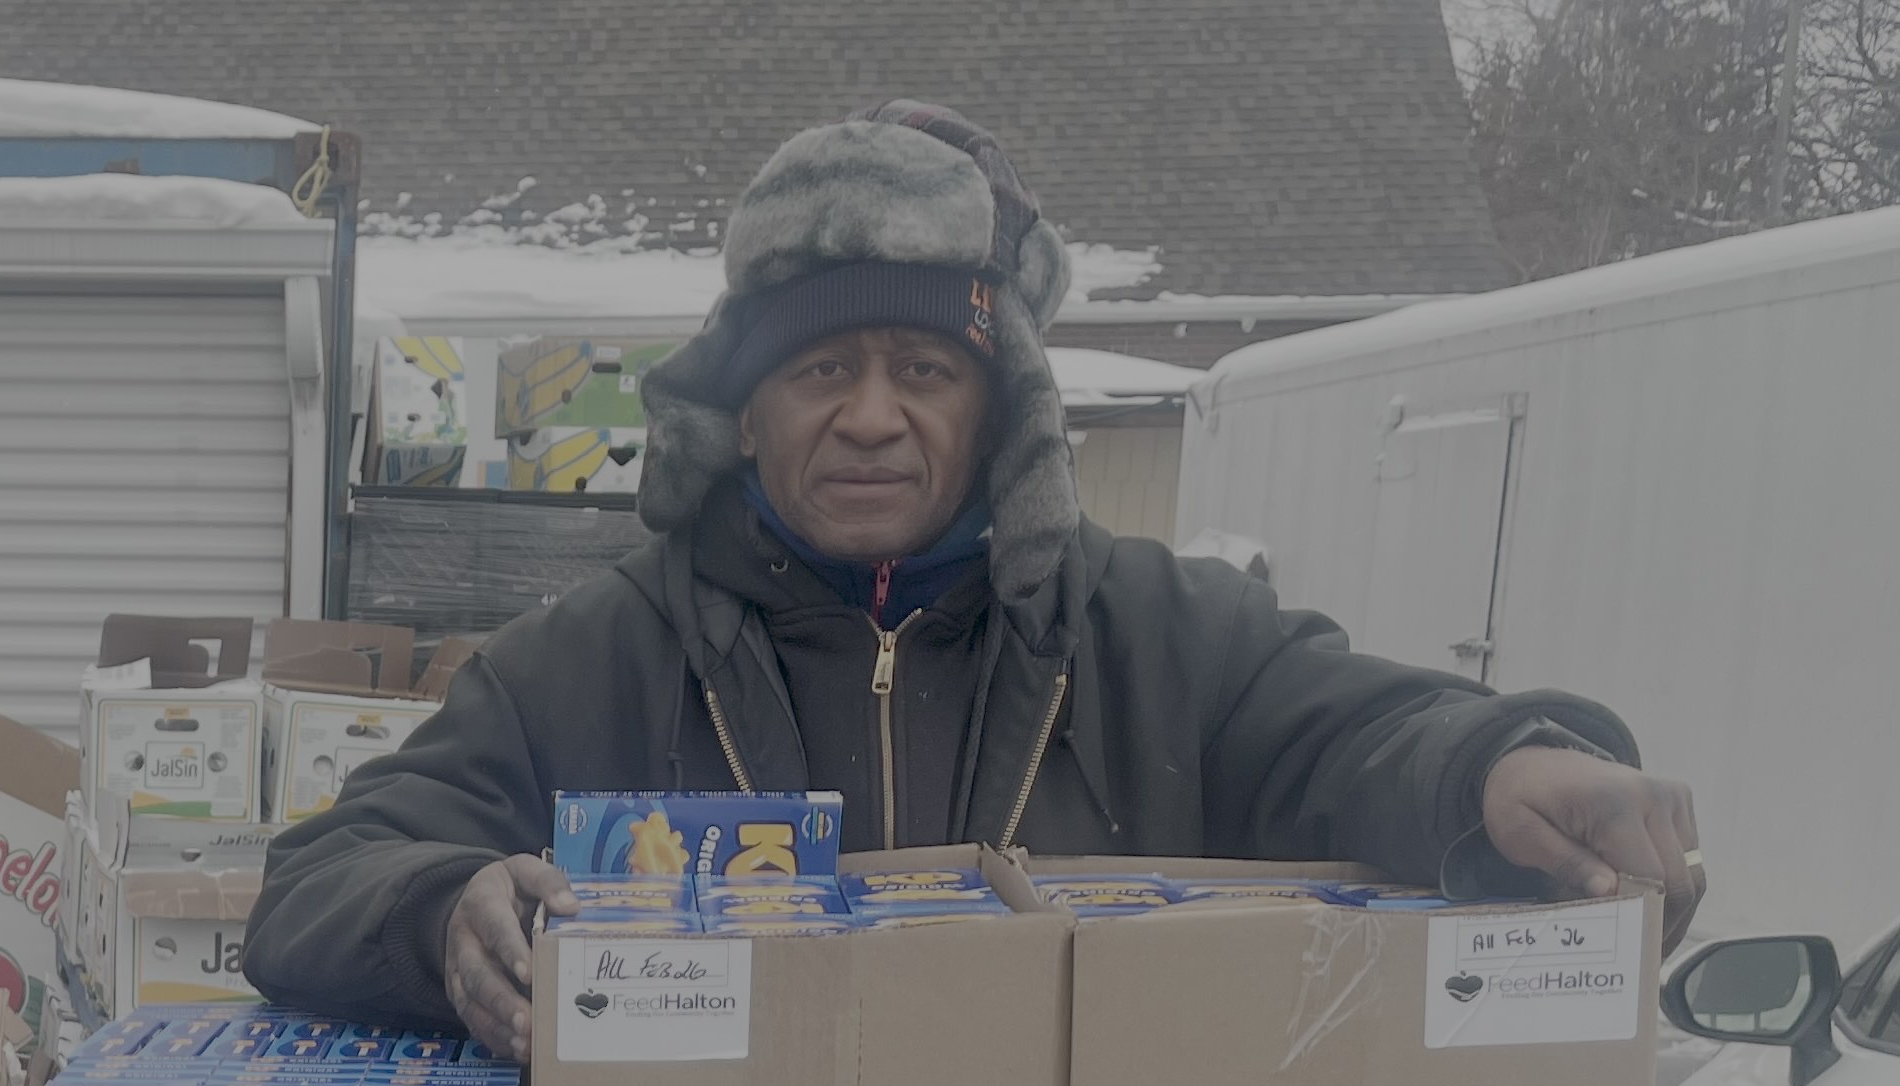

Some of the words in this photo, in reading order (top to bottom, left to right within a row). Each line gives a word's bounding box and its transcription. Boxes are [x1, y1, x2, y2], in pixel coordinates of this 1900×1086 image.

[150, 756, 198, 779] JalSin
[1487, 970, 1624, 993] FeedHalton
[612, 992, 736, 1011] FeedHalton
